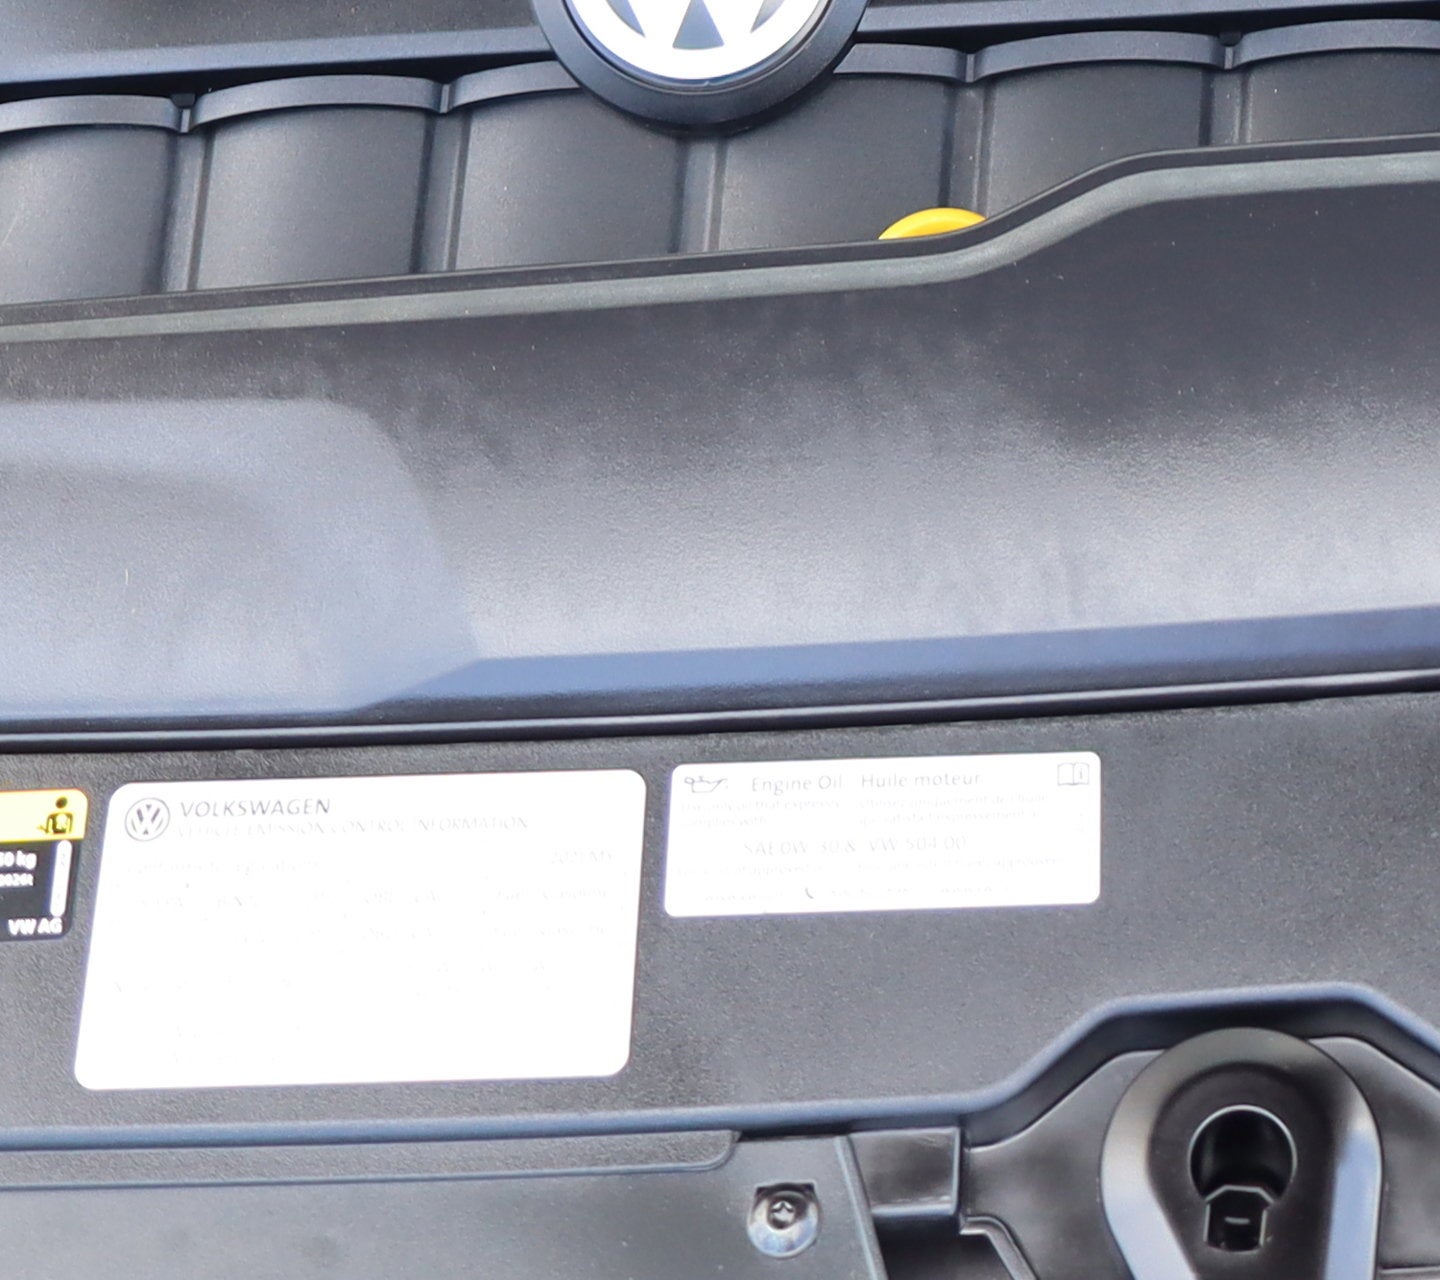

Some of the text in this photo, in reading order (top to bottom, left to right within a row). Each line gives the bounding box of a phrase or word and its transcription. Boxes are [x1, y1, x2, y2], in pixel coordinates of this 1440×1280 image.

[752, 773, 842, 796] Engine Oil
[861, 770, 980, 788] Huile moteur
[179, 797, 331, 818] VOLKSWAGEN
[8, 918, 62, 935] VW AG
